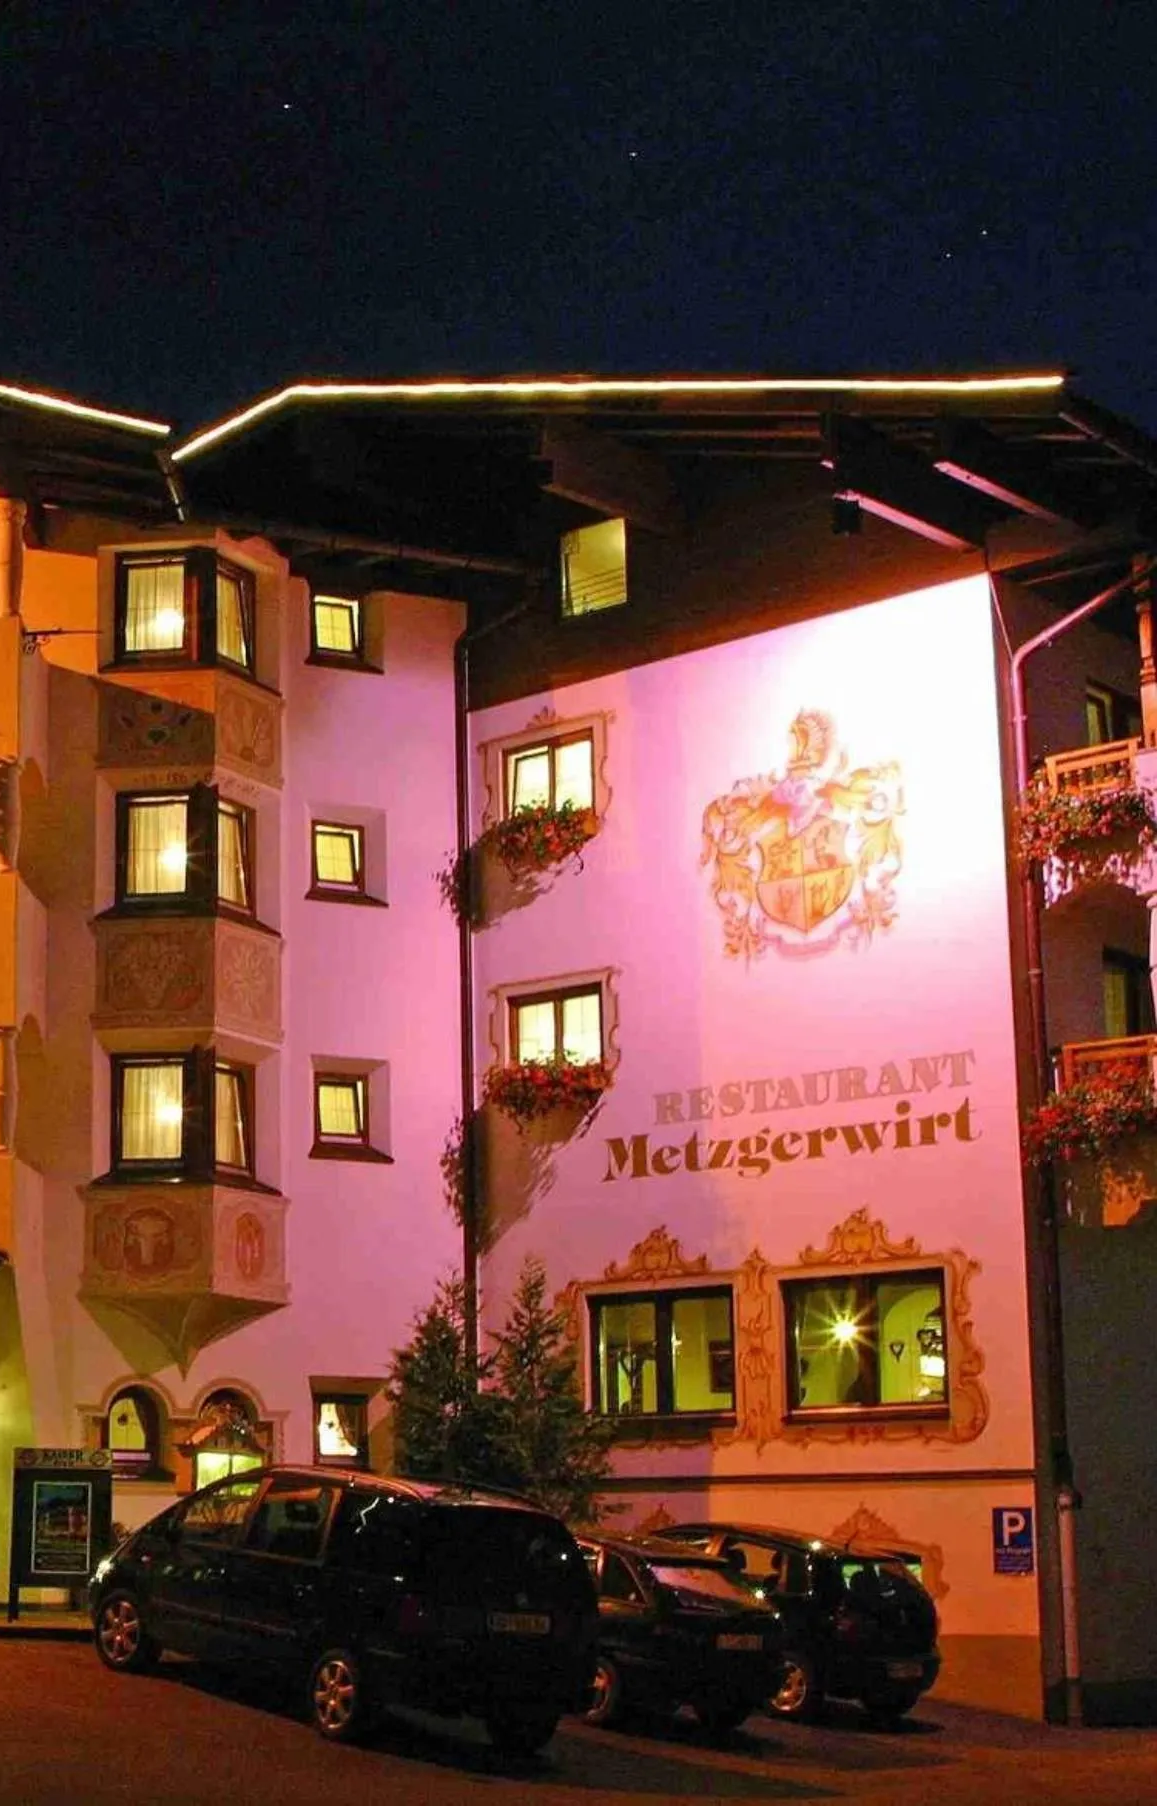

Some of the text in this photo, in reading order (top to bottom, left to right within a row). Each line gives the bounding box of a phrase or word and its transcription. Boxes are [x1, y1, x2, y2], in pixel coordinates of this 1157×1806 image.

[654, 1049, 976, 1126] RESTAURANT
[601, 1097, 983, 1183] Metzgerwirt
[1002, 1511, 1026, 1546] P
